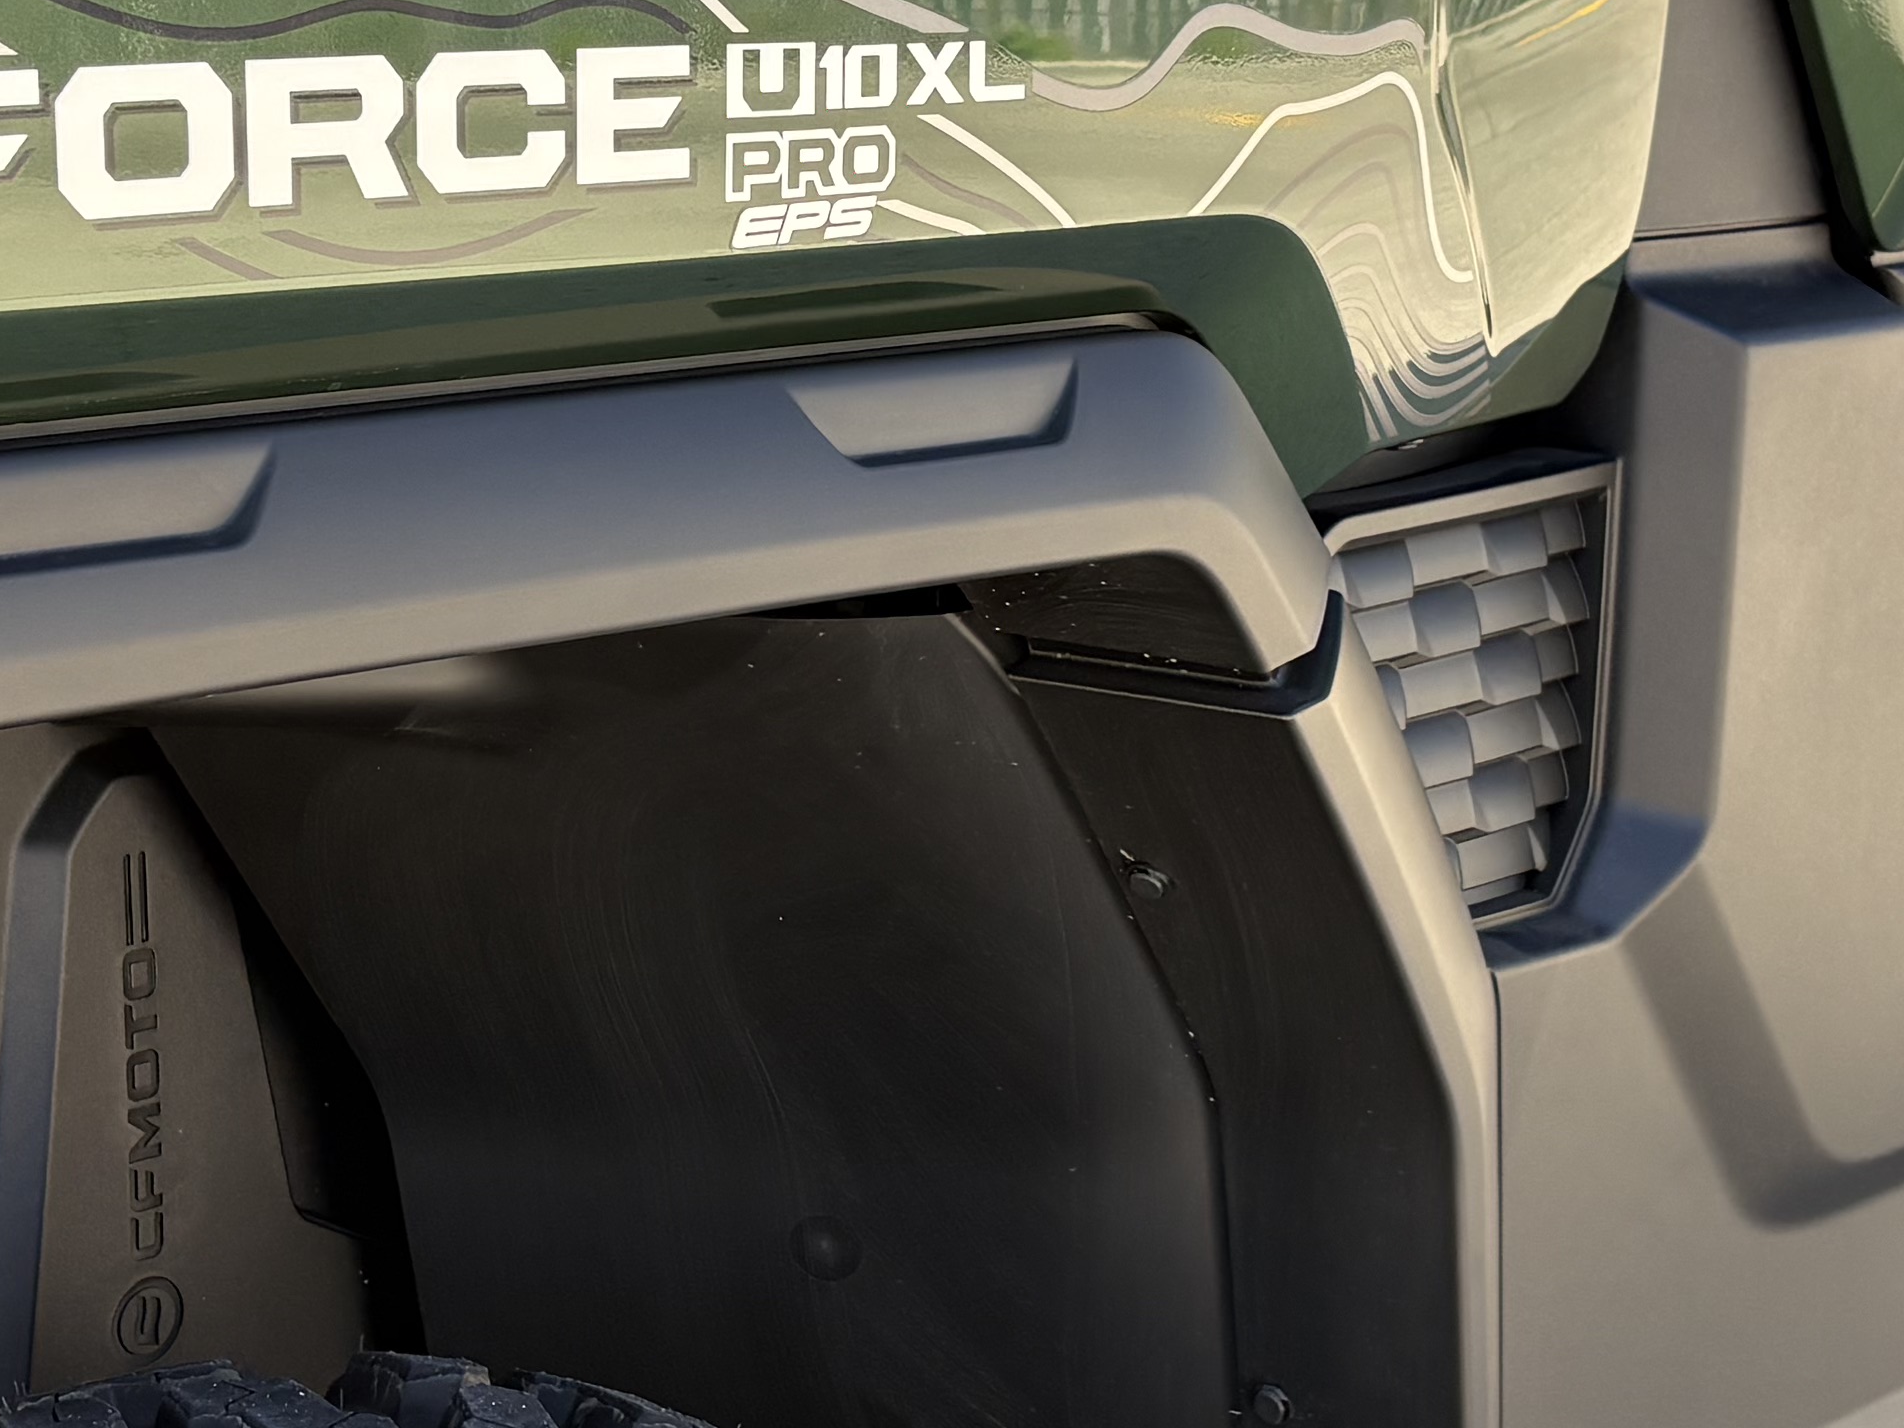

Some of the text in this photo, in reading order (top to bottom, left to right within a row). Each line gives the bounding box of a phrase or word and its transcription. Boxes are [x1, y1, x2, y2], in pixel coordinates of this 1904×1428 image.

[725, 124, 897, 203] PRO
[730, 194, 878, 250] EPS
[122, 945, 164, 1262] CFMOTO
